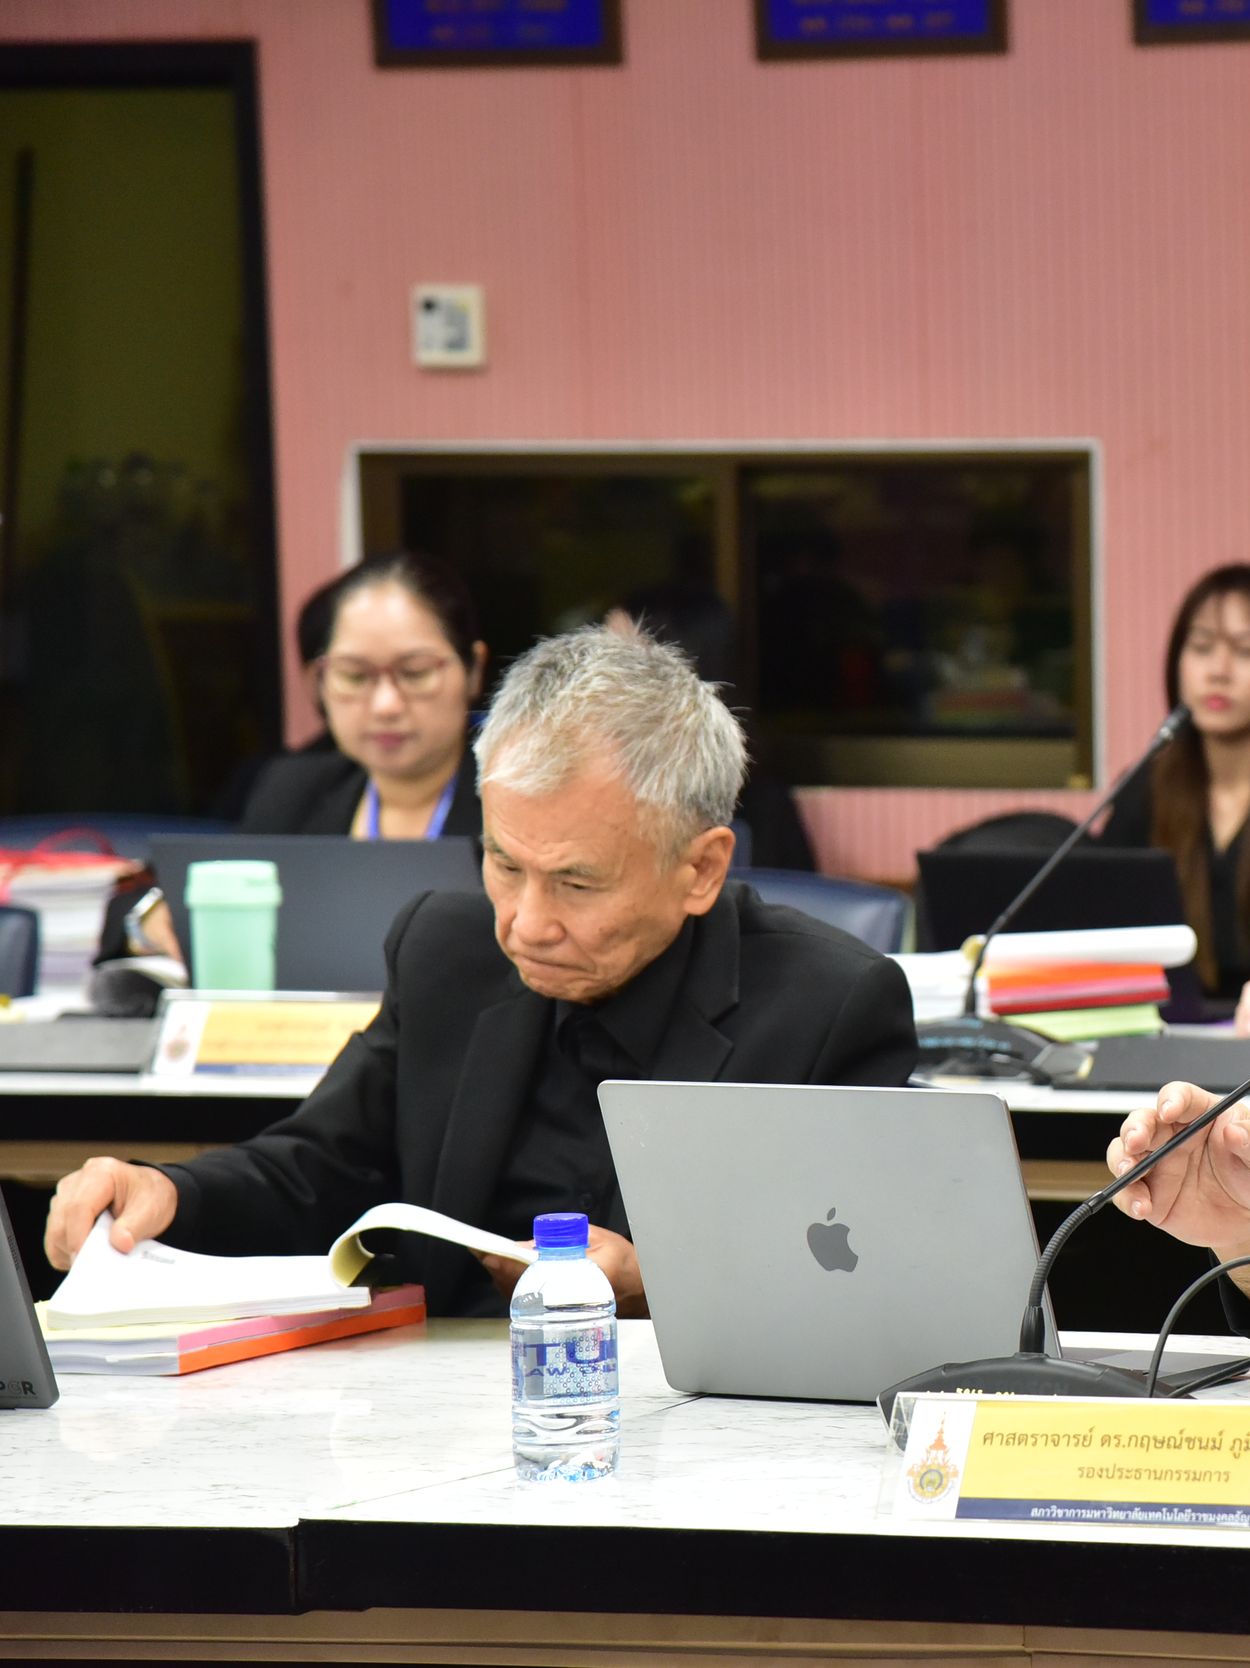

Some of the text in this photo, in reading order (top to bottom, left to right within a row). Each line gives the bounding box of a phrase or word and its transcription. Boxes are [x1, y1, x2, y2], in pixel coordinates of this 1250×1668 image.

[982, 1426, 1095, 1448] ศาสตราจารย์
[1099, 1428, 1225, 1453] ดร.กฤษณ์ชนม์
[1077, 1463, 1231, 1483] รองประธานกรรมการ
